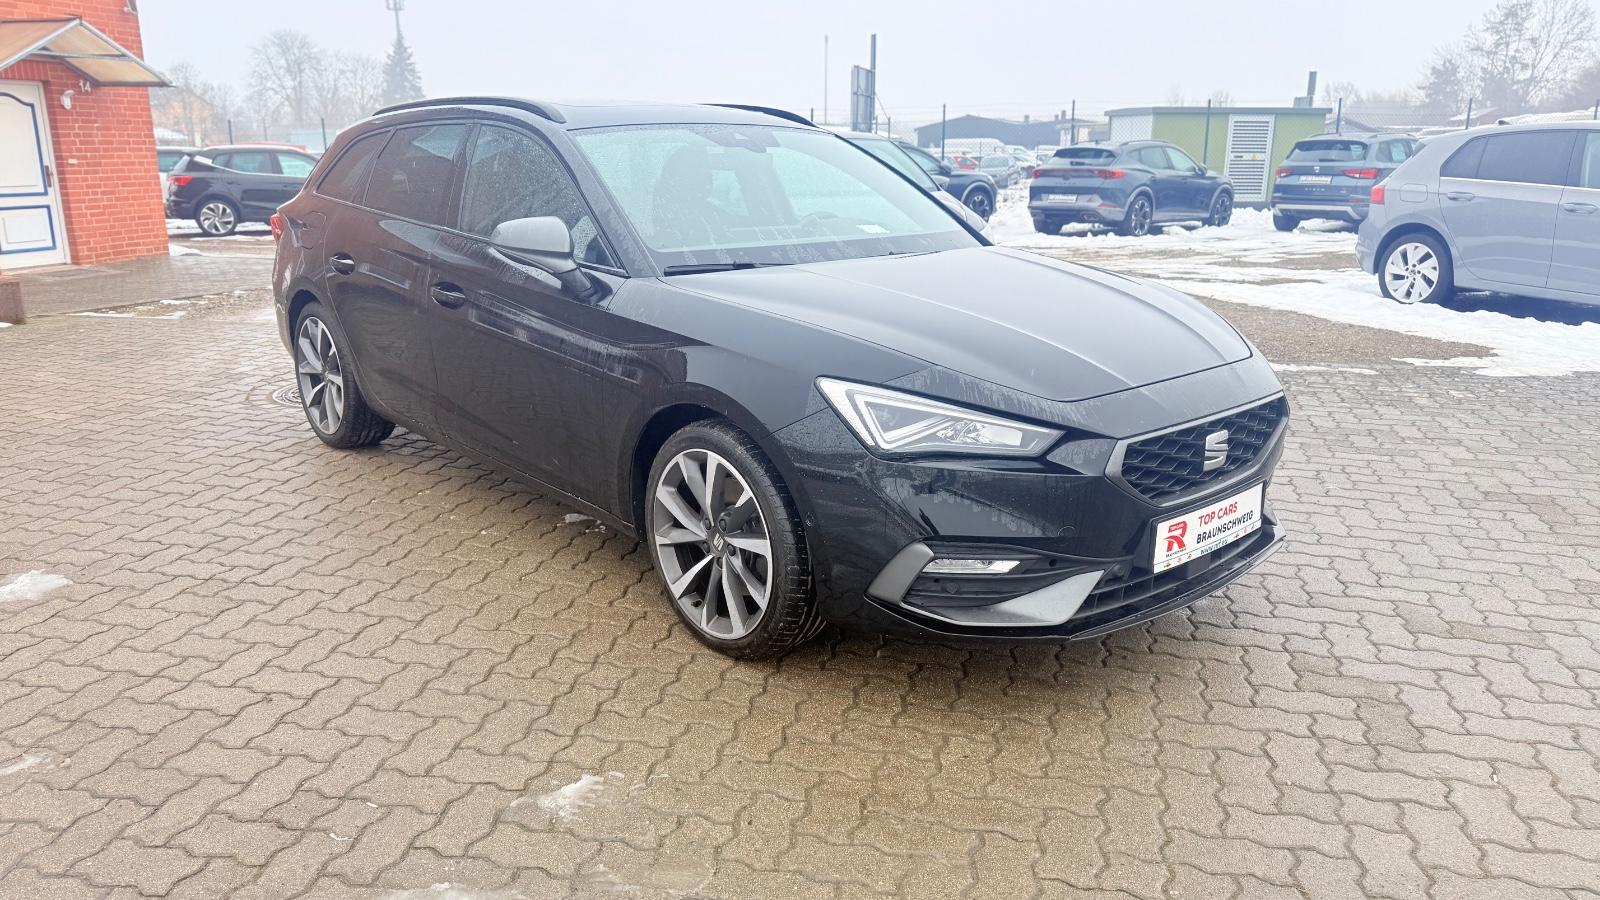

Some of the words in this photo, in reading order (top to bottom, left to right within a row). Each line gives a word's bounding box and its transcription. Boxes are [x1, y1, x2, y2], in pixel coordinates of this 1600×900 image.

[79, 79, 91, 92] 14
[1197, 510, 1254, 545] BRAUNSCHWEIG
[1198, 511, 1216, 528] TOP
[1217, 501, 1239, 519] CARS
